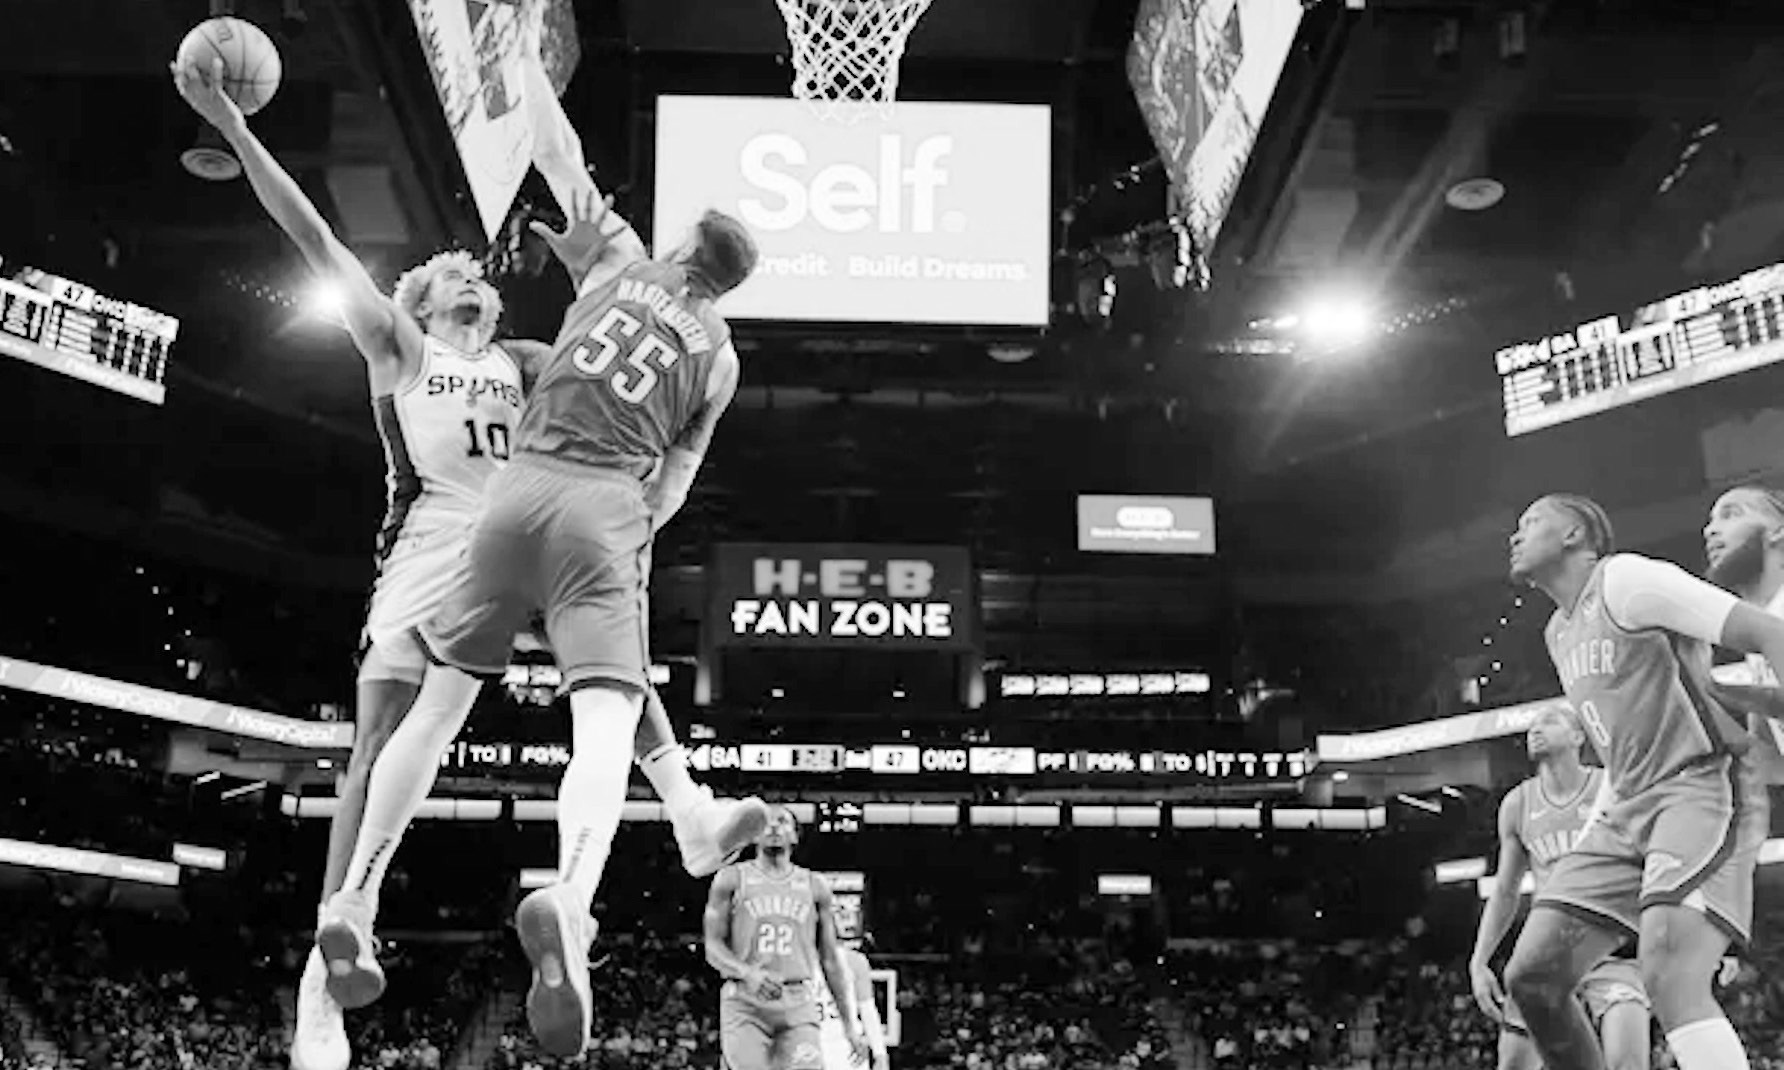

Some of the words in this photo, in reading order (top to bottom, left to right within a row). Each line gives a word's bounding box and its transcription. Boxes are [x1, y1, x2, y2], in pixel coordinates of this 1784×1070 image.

[849, 254, 919, 278] Build
[572, 306, 679, 404] 55
[464, 419, 510, 460] 10
[731, 599, 820, 635] FAN
[830, 602, 952, 637] ZONE
[711, 747, 740, 767] SA
[922, 749, 967, 770] OKC
[1162, 753, 1191, 771] TO
[758, 923, 793, 955] 22
